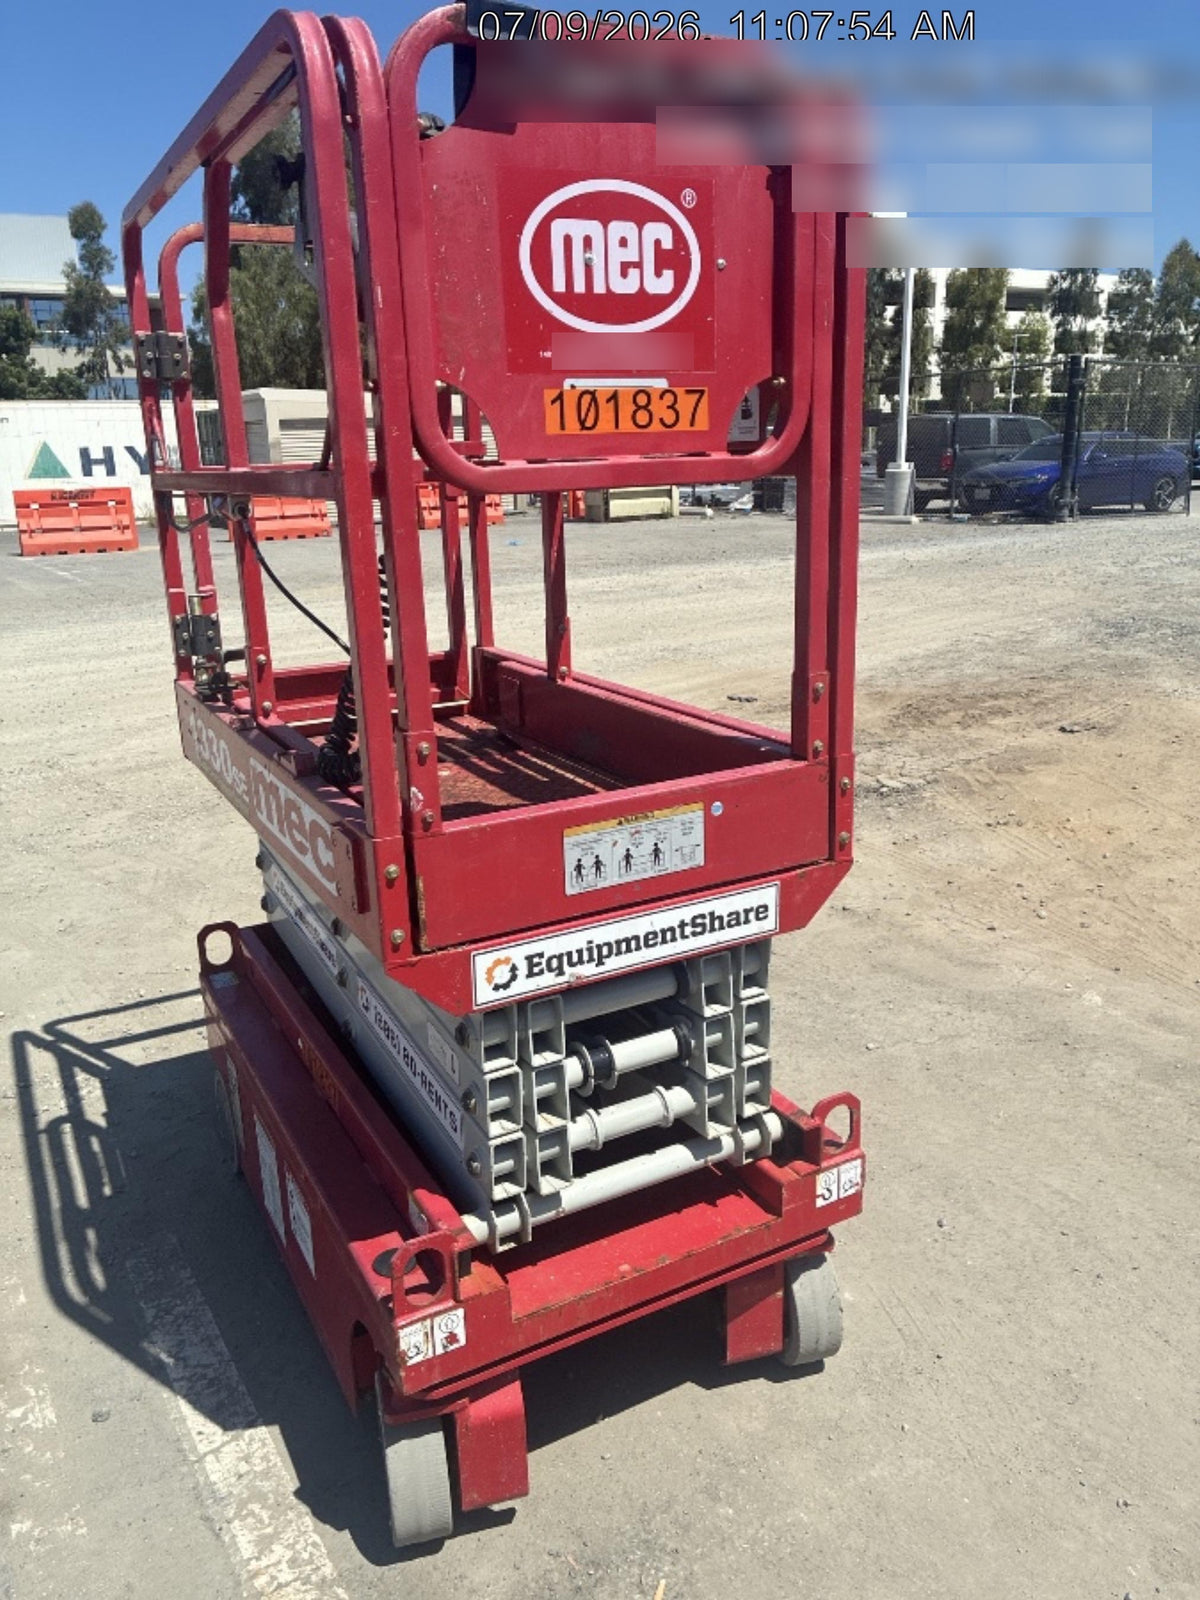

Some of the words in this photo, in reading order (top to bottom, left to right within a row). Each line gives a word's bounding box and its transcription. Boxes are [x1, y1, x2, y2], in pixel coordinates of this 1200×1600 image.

[550, 218, 675, 294] mec
[550, 389, 706, 431] 101837
[524, 902, 770, 980] EquipmentShare
